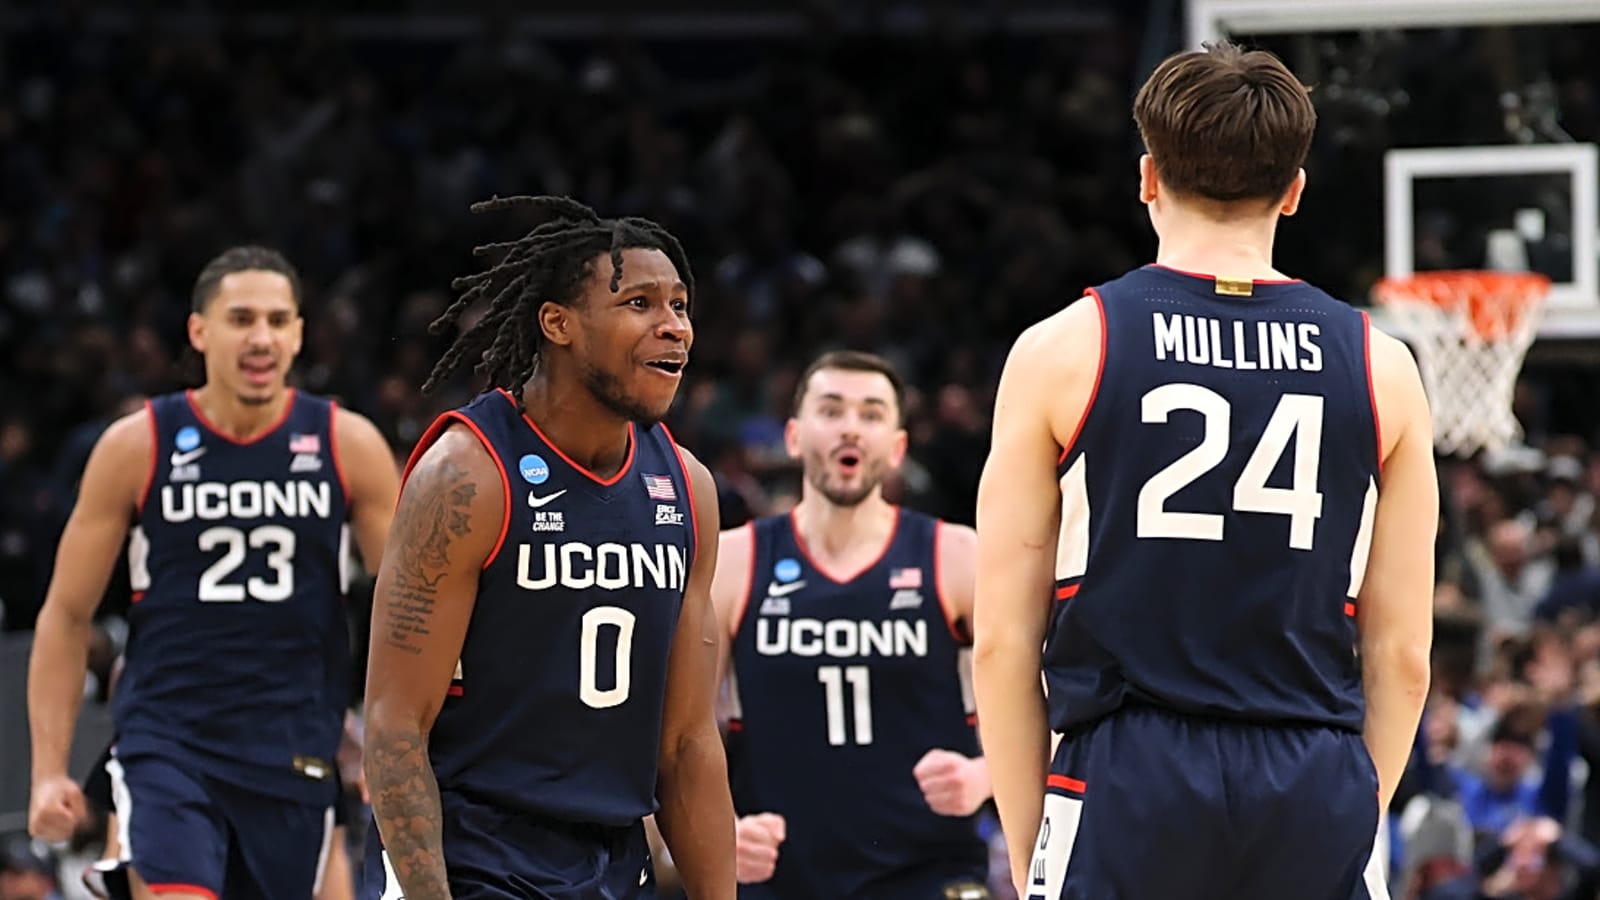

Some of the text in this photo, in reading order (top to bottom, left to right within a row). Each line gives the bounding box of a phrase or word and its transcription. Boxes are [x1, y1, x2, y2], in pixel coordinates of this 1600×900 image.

[1152, 312, 1323, 372] MULLINS
[523, 467, 549, 477] NCAA
[1136, 383, 1324, 551] 24
[161, 480, 331, 522] UCONN
[535, 511, 563, 522] BE THE
[655, 512, 684, 521] EAST
[656, 504, 676, 513] BIG
[532, 521, 565, 532] CHANGE
[198, 525, 295, 602] 23
[516, 542, 687, 593] UCONN
[579, 605, 636, 709] 0
[756, 618, 928, 657] UCONN
[818, 666, 873, 746] 11
